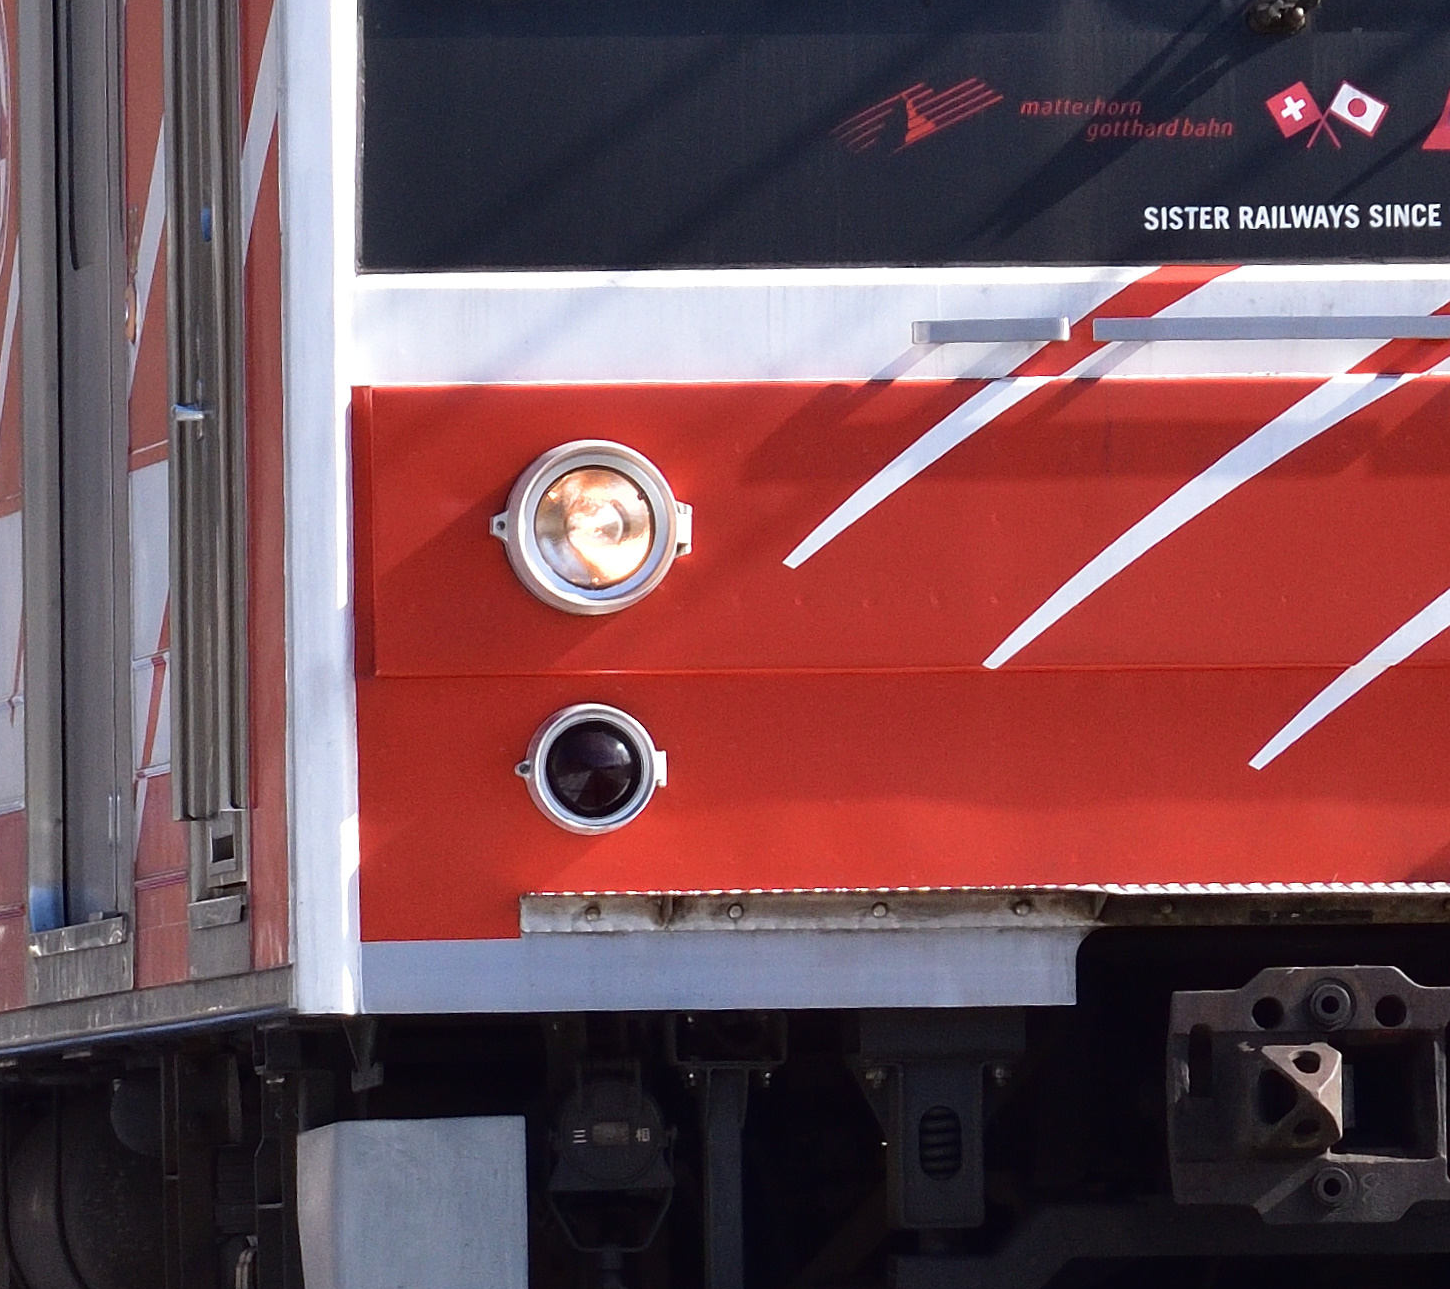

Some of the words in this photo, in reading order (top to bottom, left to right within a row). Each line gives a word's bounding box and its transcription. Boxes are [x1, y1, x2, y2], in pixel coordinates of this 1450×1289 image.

[1086, 118, 1179, 142] gotthard
[1182, 118, 1233, 137] bahn
[1144, 206, 1230, 231] SISTER
[1239, 204, 1361, 230] RAILWAYS
[1369, 203, 1442, 228] SINCE
